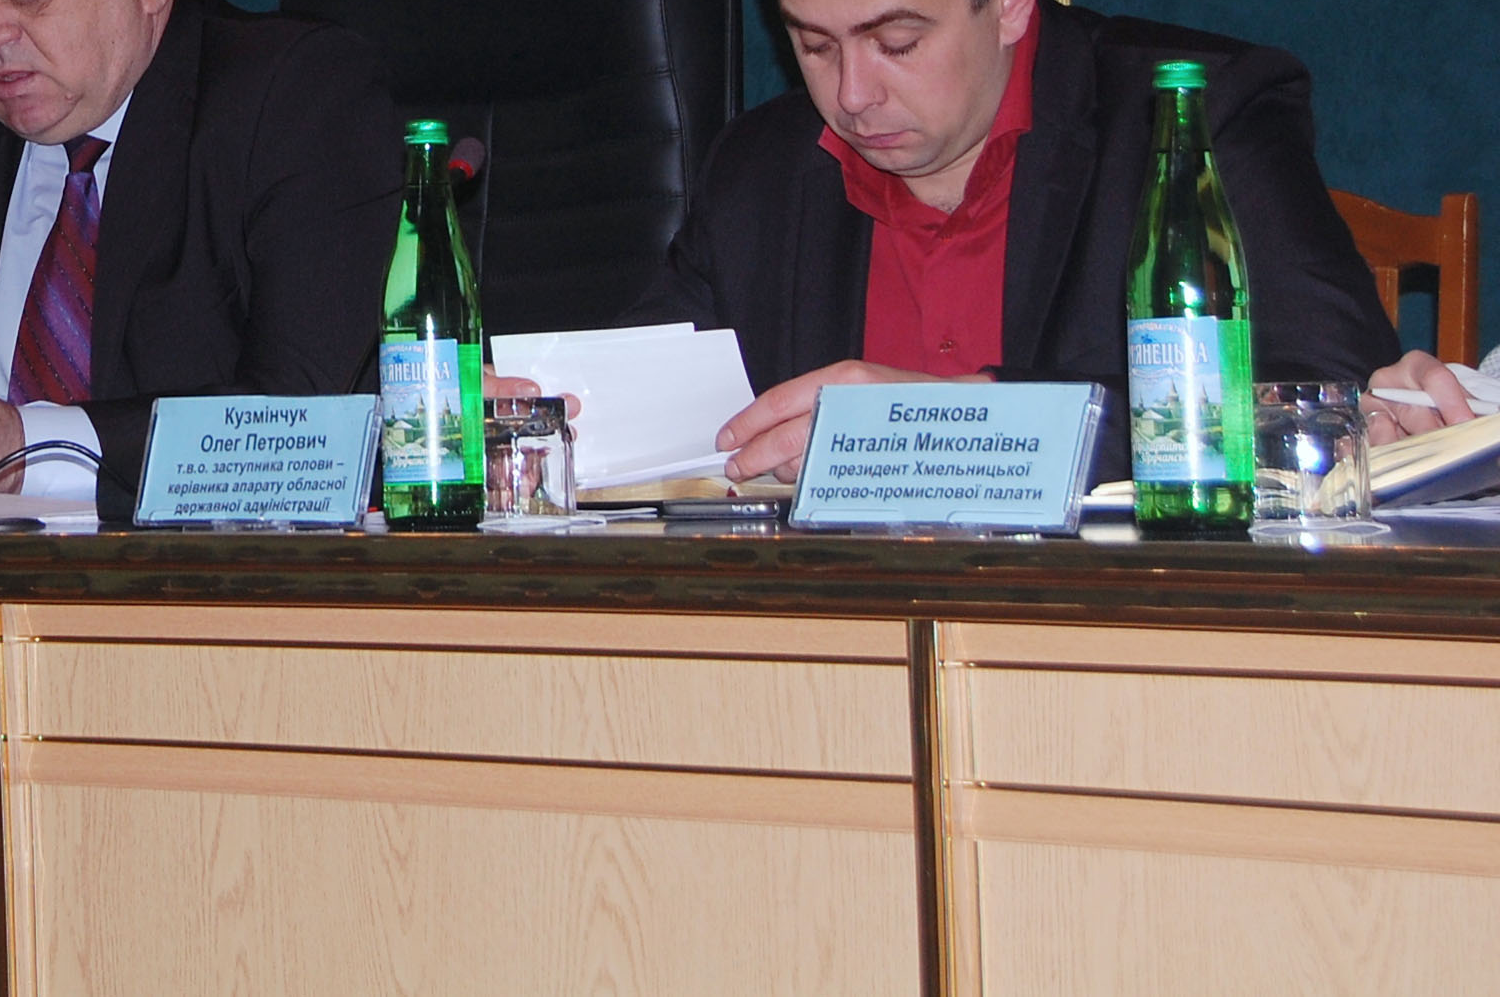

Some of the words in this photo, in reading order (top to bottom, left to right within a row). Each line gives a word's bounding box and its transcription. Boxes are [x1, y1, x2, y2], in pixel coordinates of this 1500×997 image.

[224, 406, 308, 429] Кузмінчук
[888, 402, 989, 423] Бєлякова
[200, 434, 242, 453] Олег
[245, 433, 327, 454] Петрович
[830, 432, 908, 453] Наталія
[913, 432, 1040, 453] Миколаївна
[176, 462, 209, 475] т.в.о.
[212, 460, 284, 477] заступника
[287, 459, 333, 472] голови
[829, 462, 909, 478] президент
[912, 461, 1033, 478] Хмельницької
[168, 480, 229, 496] керівника
[231, 480, 284, 496] апарату
[287, 476, 347, 492] обласної
[810, 485, 981, 502] торгово-промислової
[984, 487, 1042, 501] палати
[174, 499, 242, 516] державної
[243, 497, 332, 514] адміністрації
